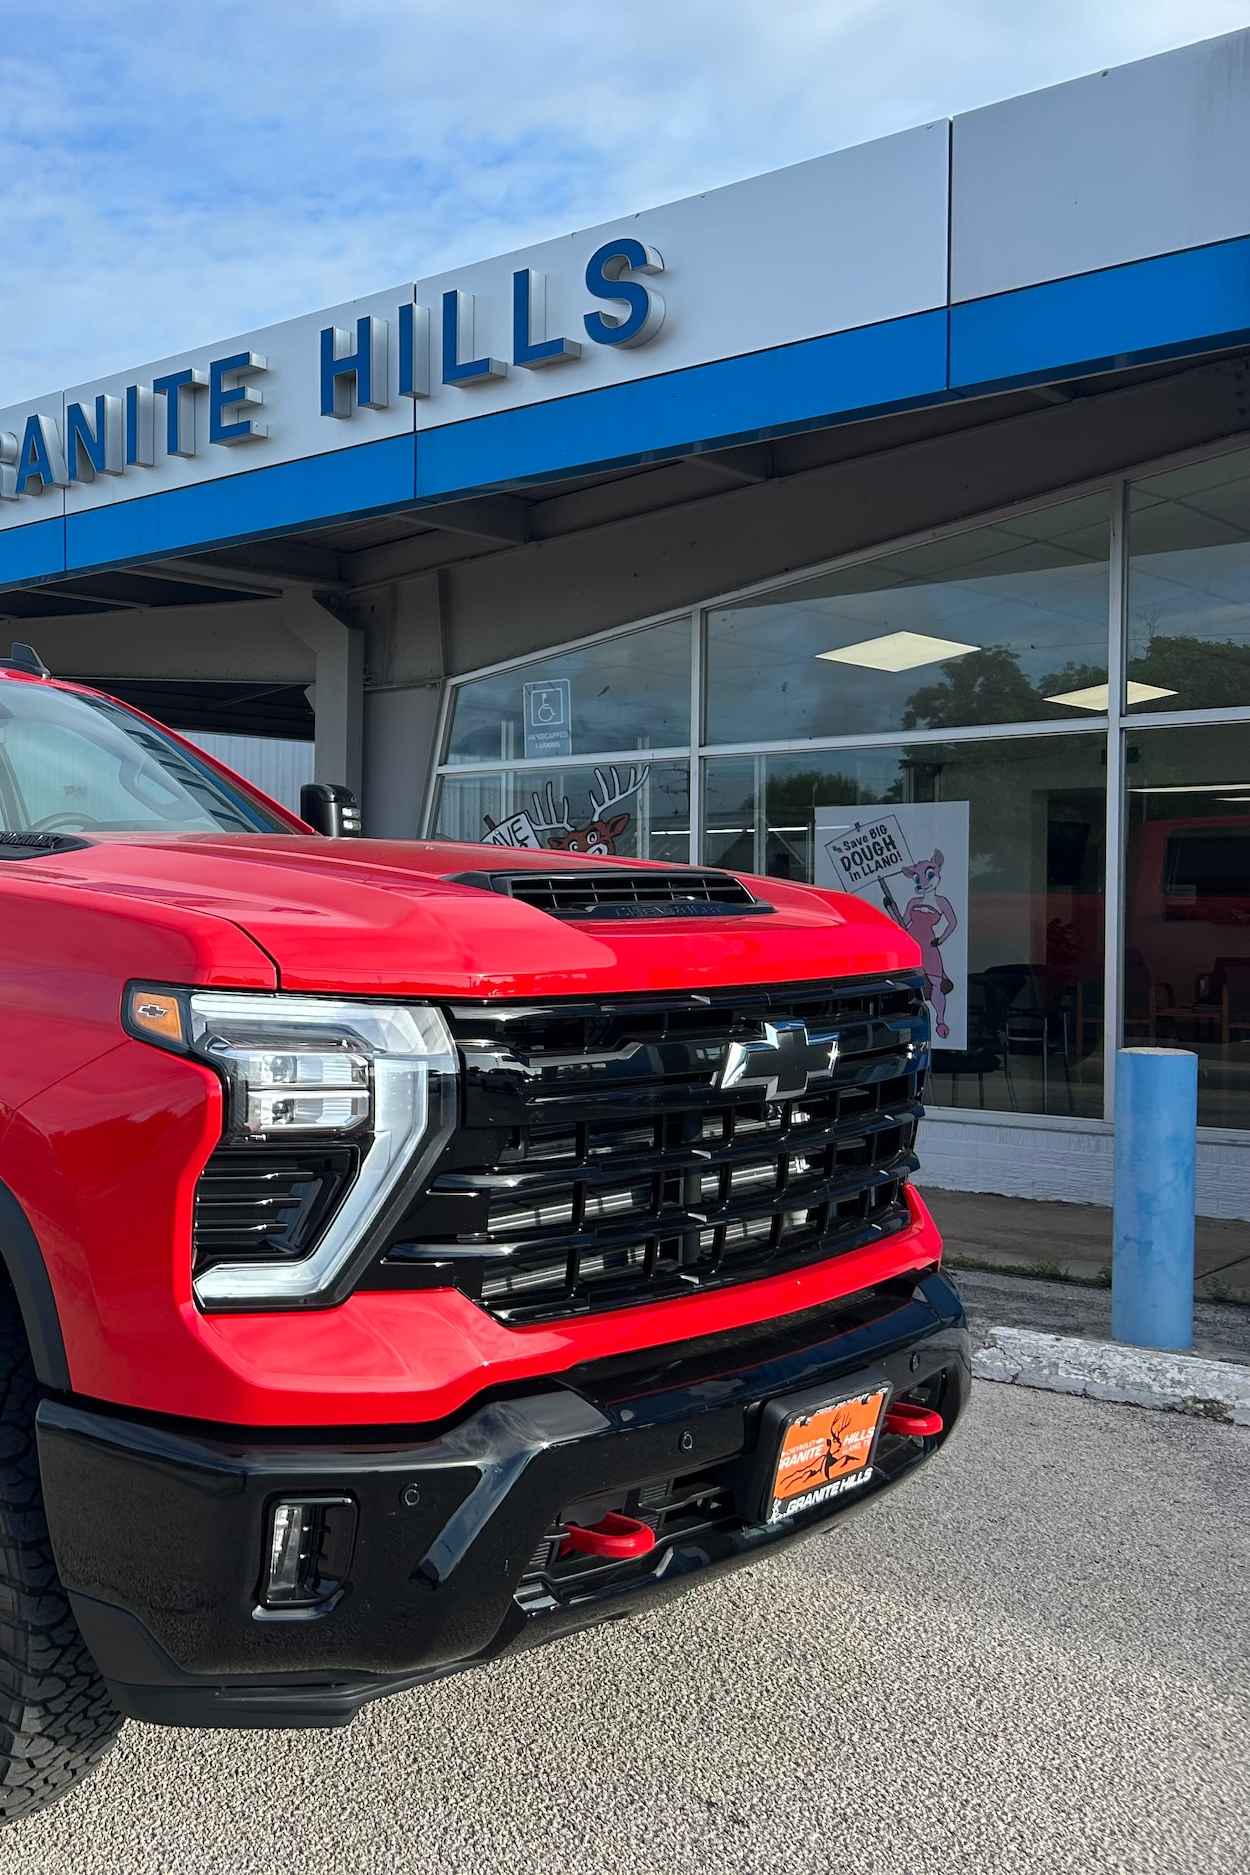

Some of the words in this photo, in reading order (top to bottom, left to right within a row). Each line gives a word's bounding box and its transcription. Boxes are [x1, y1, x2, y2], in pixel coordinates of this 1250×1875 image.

[320, 238, 665, 419] HILLS
[527, 731, 568, 741] HANDICAPPED
[535, 741, 561, 749] PARKING
[492, 818, 529, 847] AVE
[869, 824, 888, 839] BIG
[840, 834, 897, 872] DOUGH
[861, 851, 903, 876] LLANO!
[843, 1426, 875, 1446] HILLS
[787, 1481, 841, 1513] GRANITE
[840, 1467, 873, 1492] HILLS
